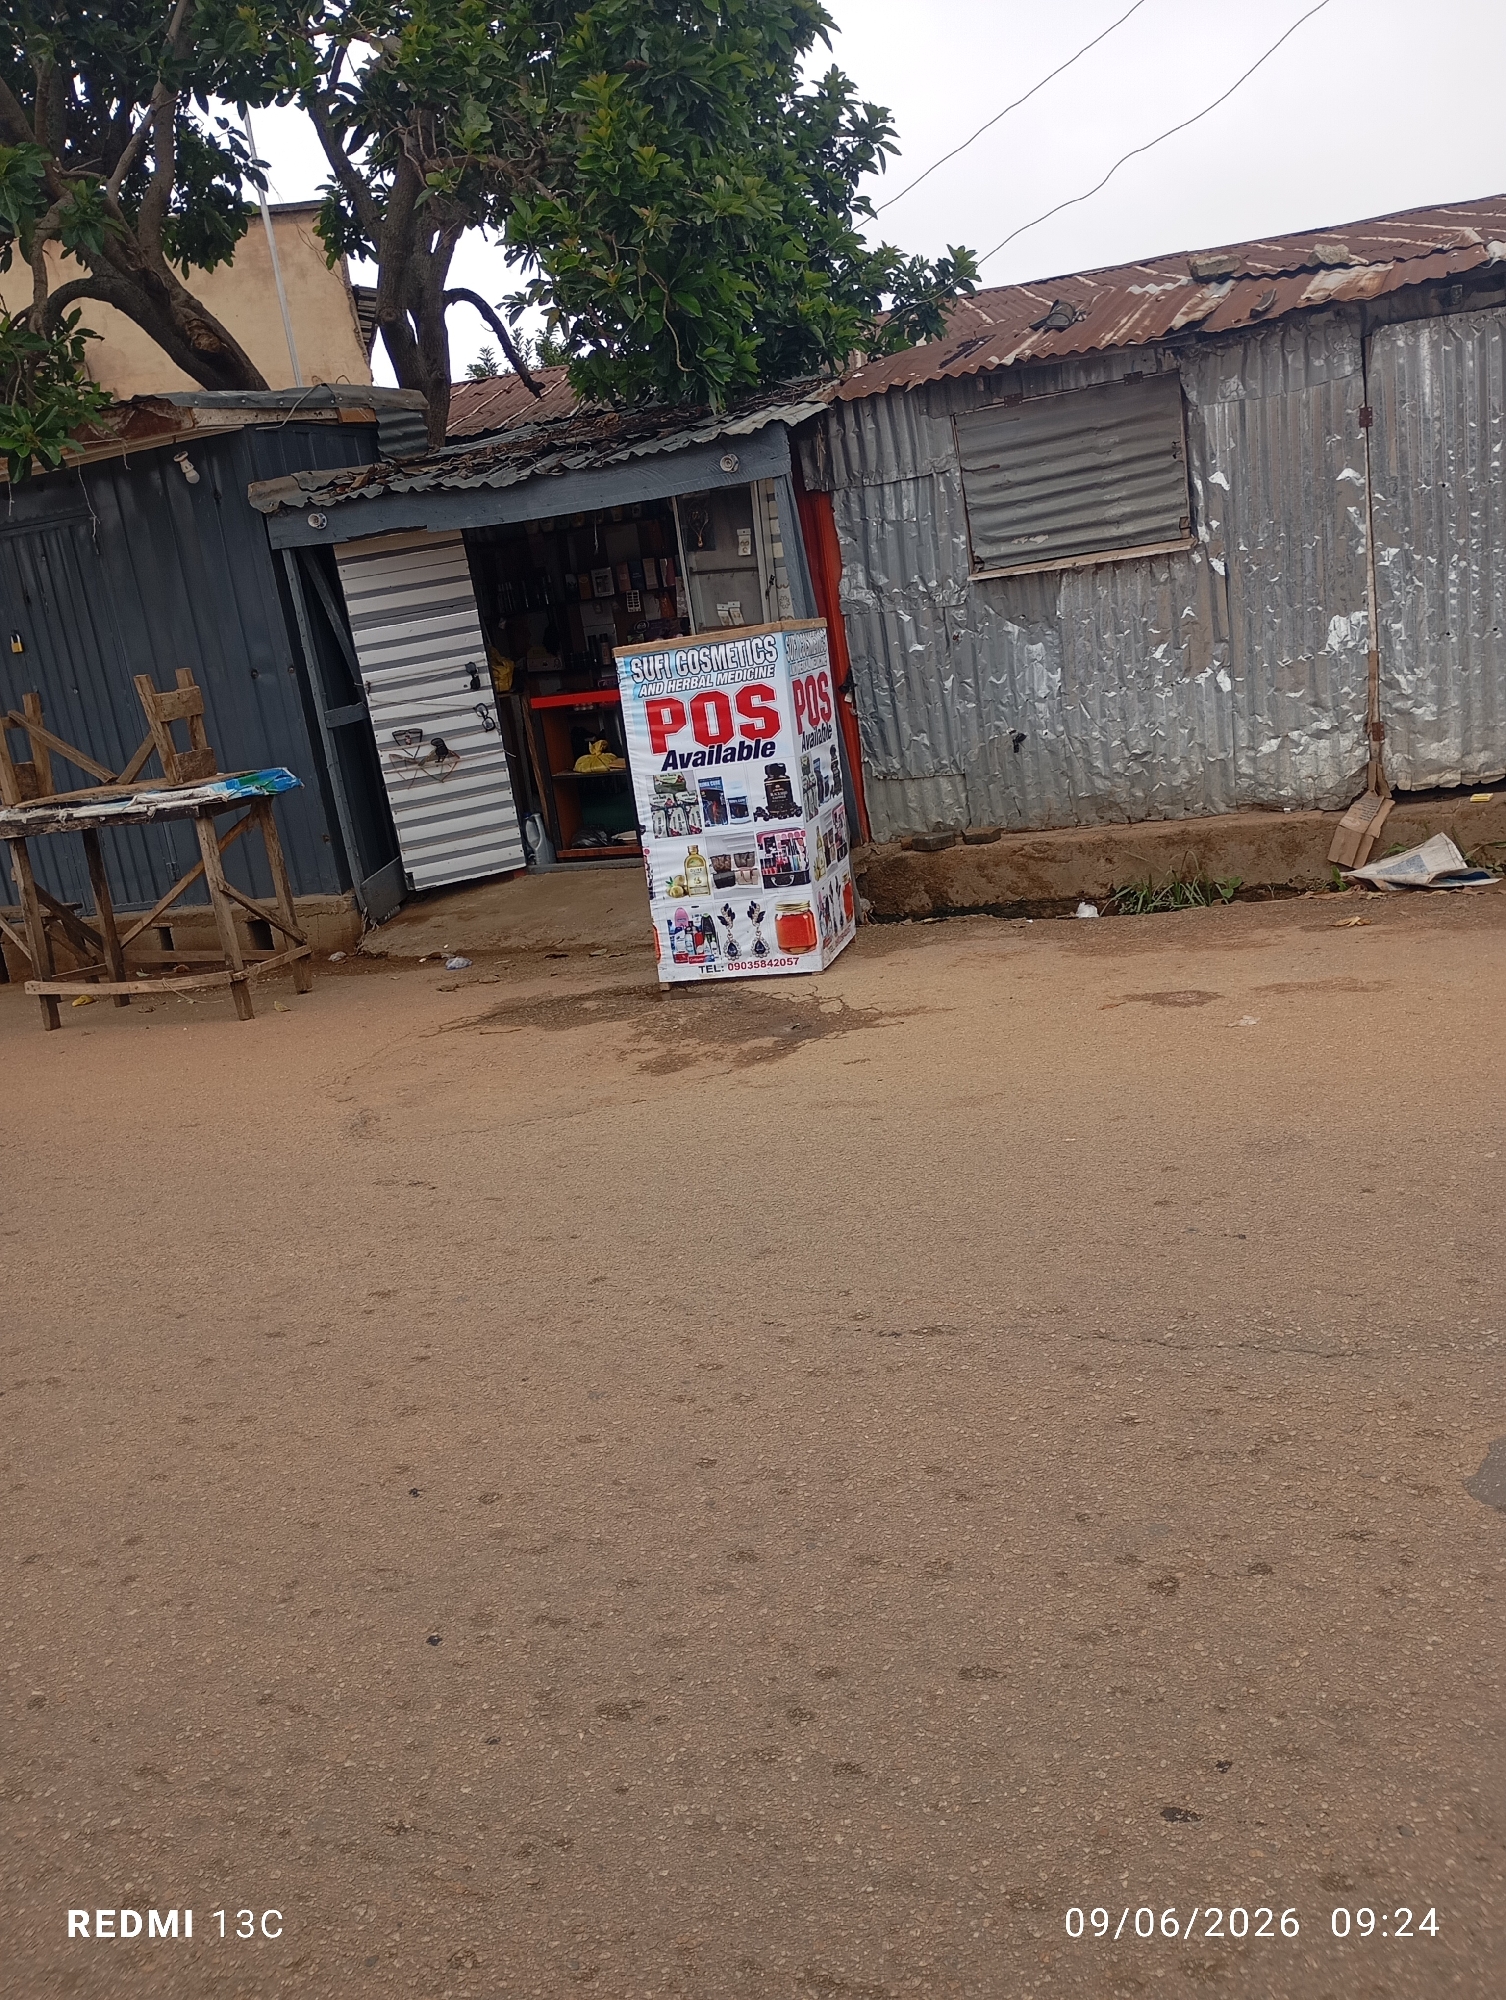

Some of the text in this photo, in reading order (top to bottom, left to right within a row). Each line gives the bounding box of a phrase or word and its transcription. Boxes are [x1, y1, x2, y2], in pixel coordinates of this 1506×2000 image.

[630, 653, 671, 684] SUFI
[675, 635, 779, 677] COSMETICS
[638, 681, 664, 698] AND
[667, 675, 713, 695] HERBAL
[716, 664, 776, 686] MEDICINE
[645, 682, 782, 755] POS
[792, 671, 832, 736] POS
[661, 738, 776, 772] Available
[698, 957, 800, 974] TEL: 09035842057
